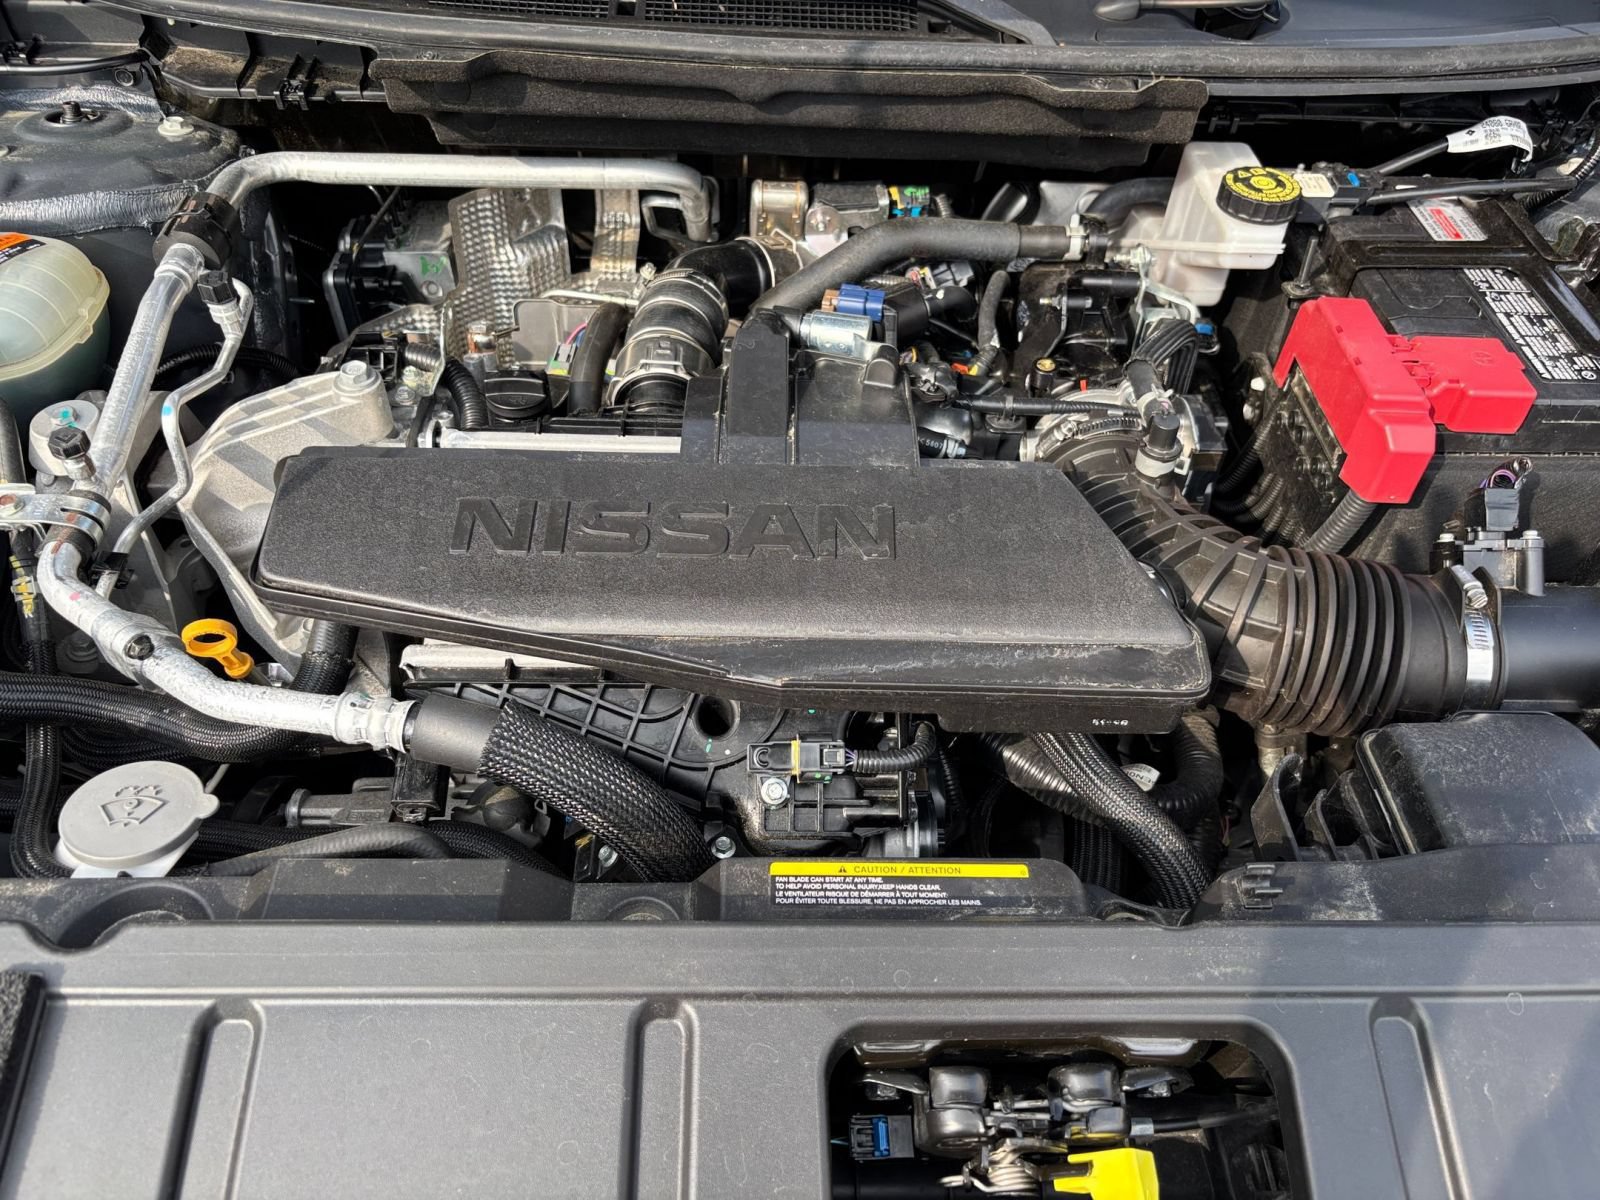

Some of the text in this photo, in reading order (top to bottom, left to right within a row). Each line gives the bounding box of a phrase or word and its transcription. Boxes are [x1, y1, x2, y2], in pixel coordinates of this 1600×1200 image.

[449, 498, 896, 561] NISSAN
[853, 865, 897, 874] CAUTION
[908, 866, 962, 875] ATTENTION
[850, 890, 859, 898] DE
[860, 889, 894, 898] DÉMARRER
[794, 896, 816, 904] ÉVITER
[907, 898, 946, 906] APPROCHER
